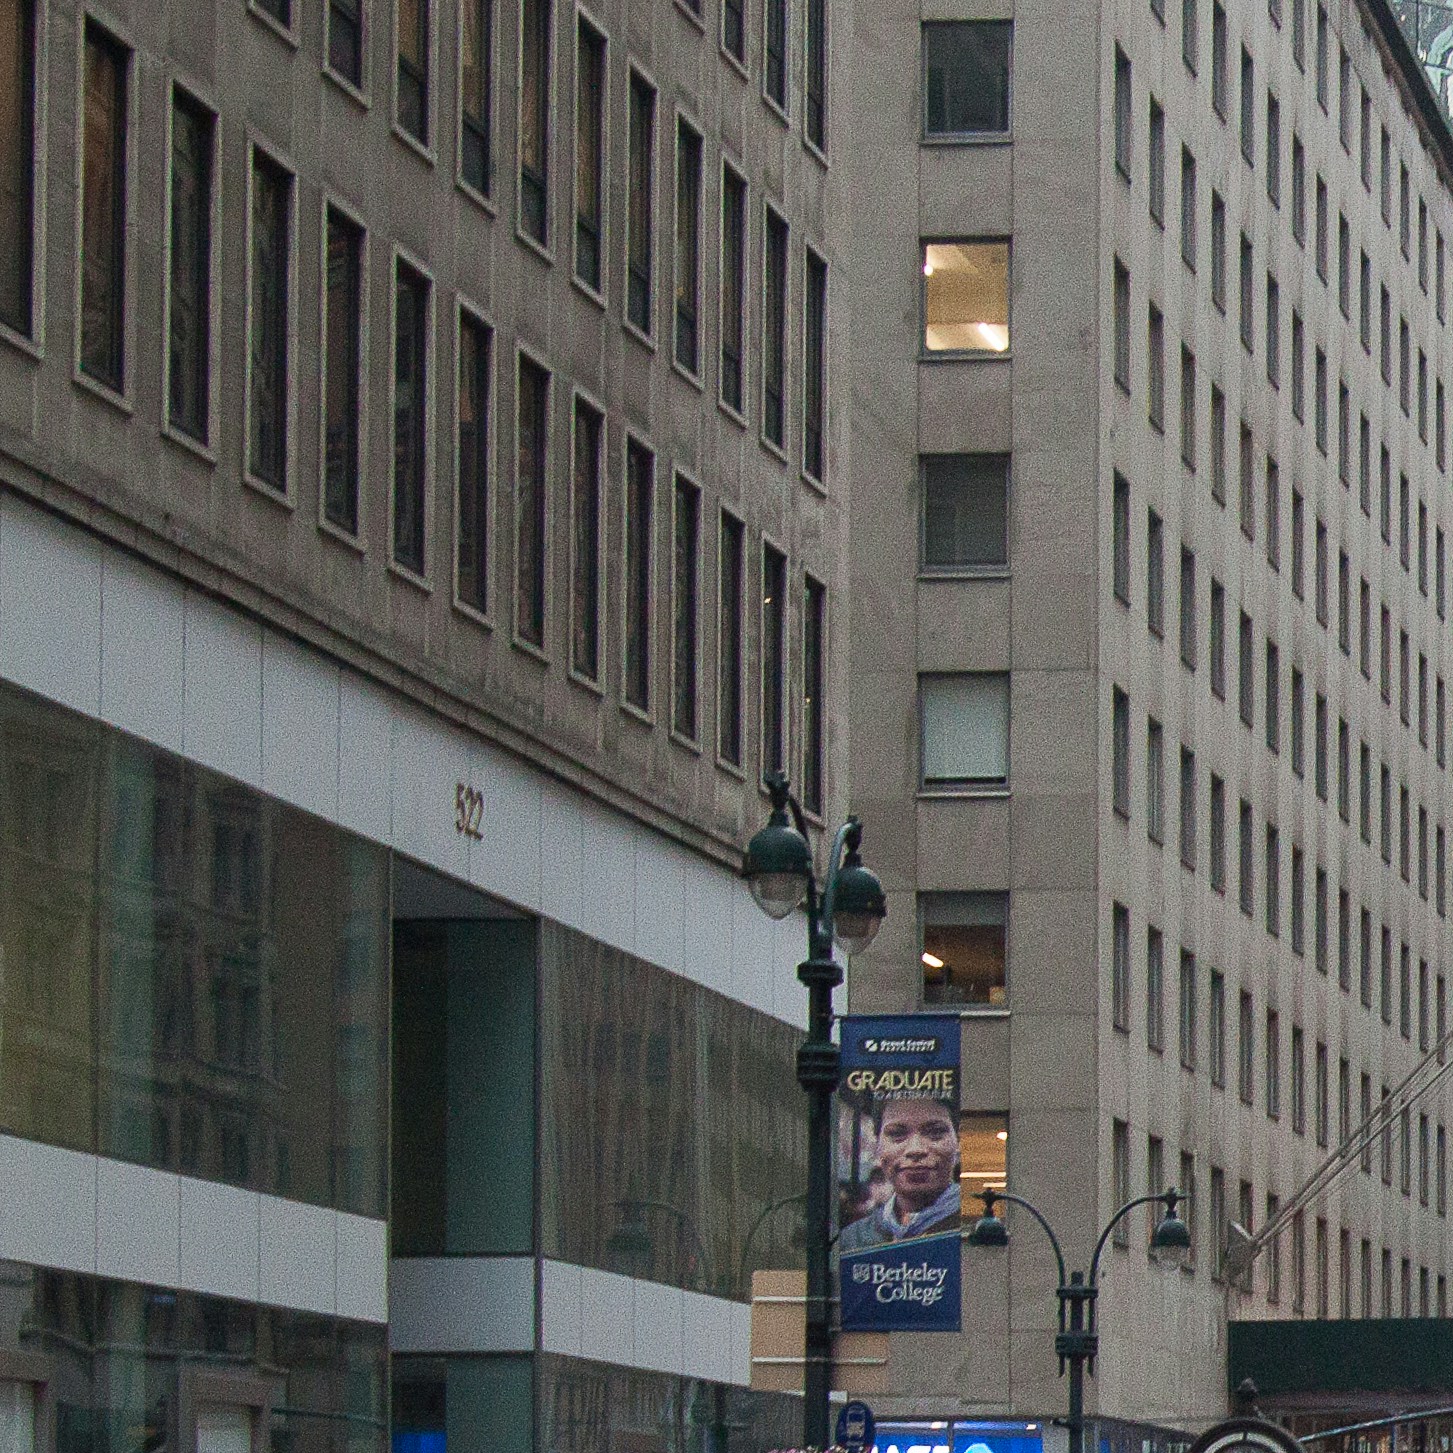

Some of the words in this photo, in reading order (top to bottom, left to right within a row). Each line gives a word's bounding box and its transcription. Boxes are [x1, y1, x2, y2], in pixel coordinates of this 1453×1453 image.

[453, 783, 483, 840] 522
[847, 1069, 955, 1091] GRADUATE
[872, 1262, 948, 1287] Berkeley
[876, 1281, 945, 1307] College
